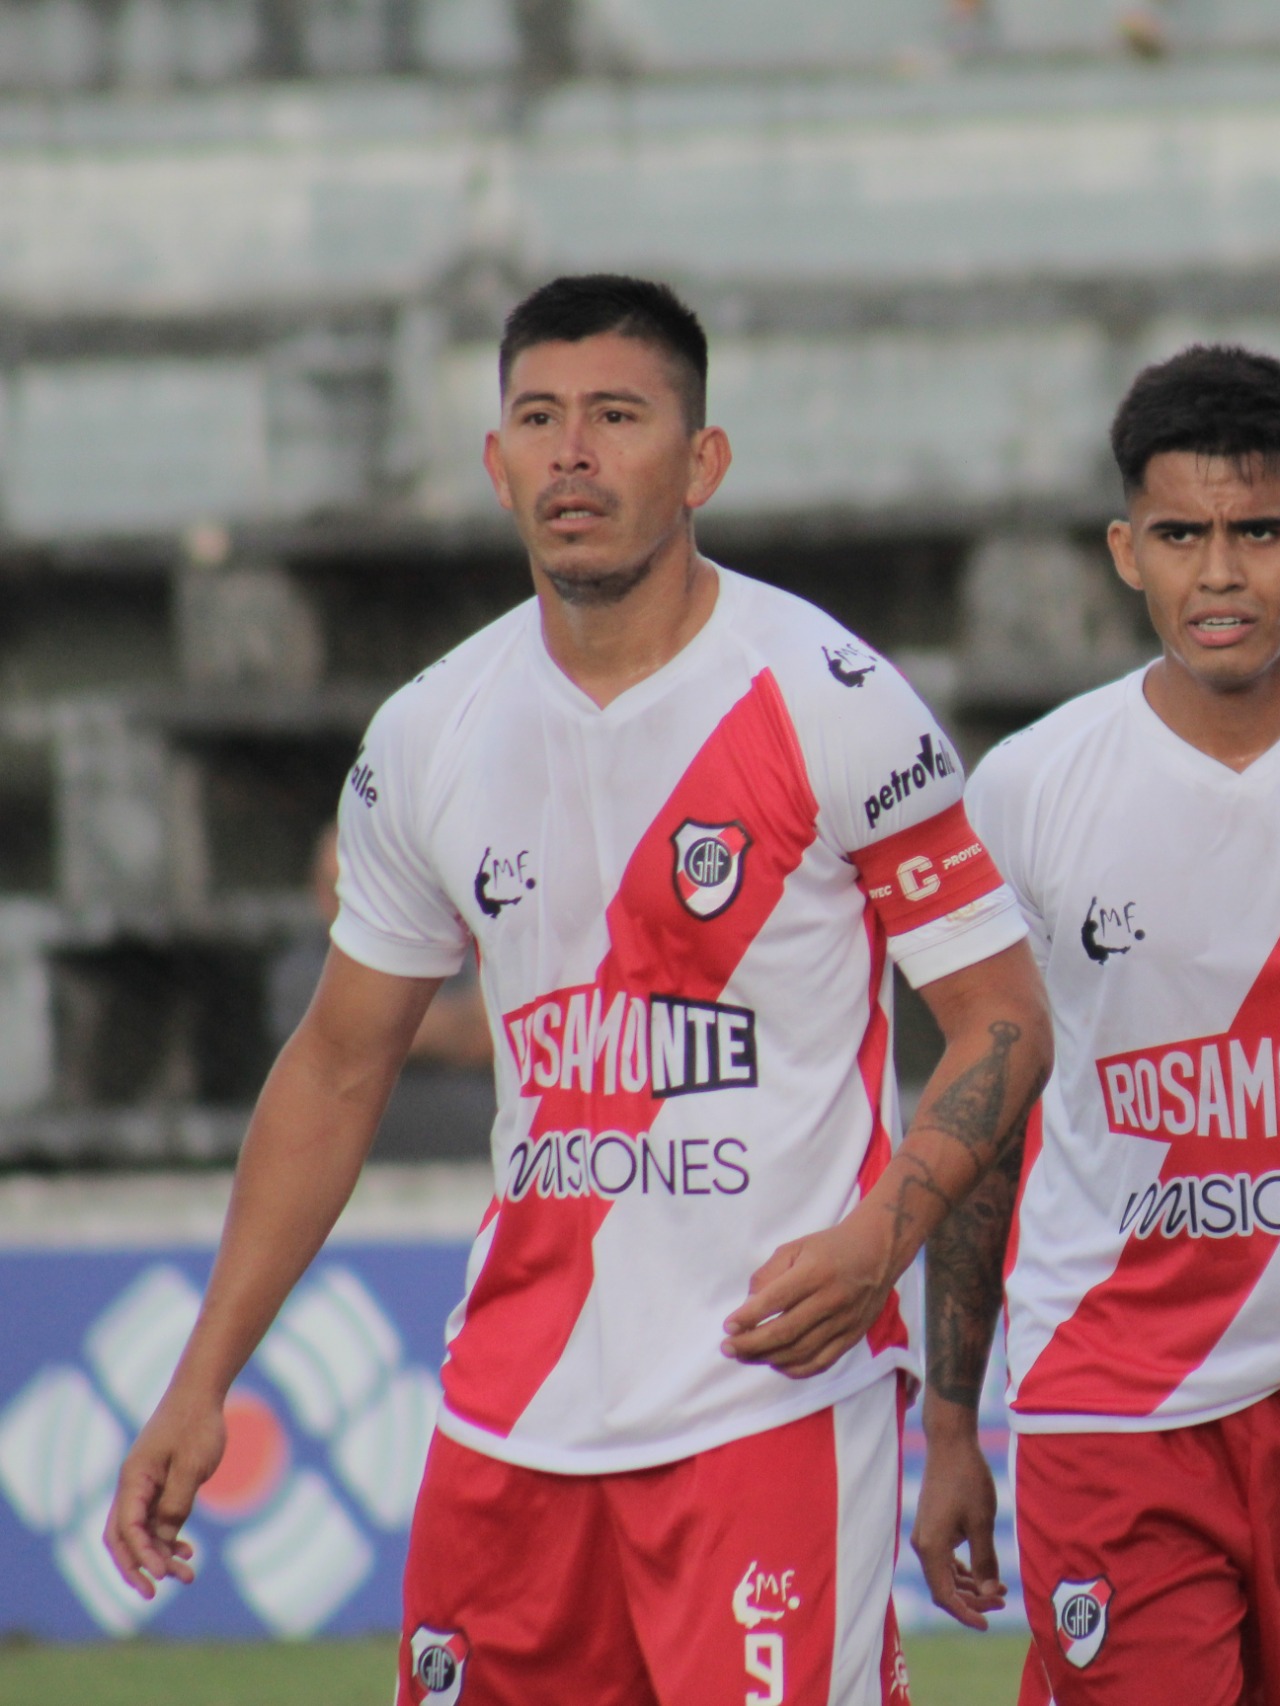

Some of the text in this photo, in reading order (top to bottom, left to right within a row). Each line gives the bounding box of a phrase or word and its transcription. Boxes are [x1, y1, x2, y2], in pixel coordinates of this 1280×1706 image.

[692, 841, 729, 884] GAF
[896, 855, 941, 901] C
[942, 843, 982, 870] PROYEC
[1064, 1598, 1097, 1636] GAF
[420, 1647, 453, 1690] GAF
[745, 1634, 782, 1706] 9
